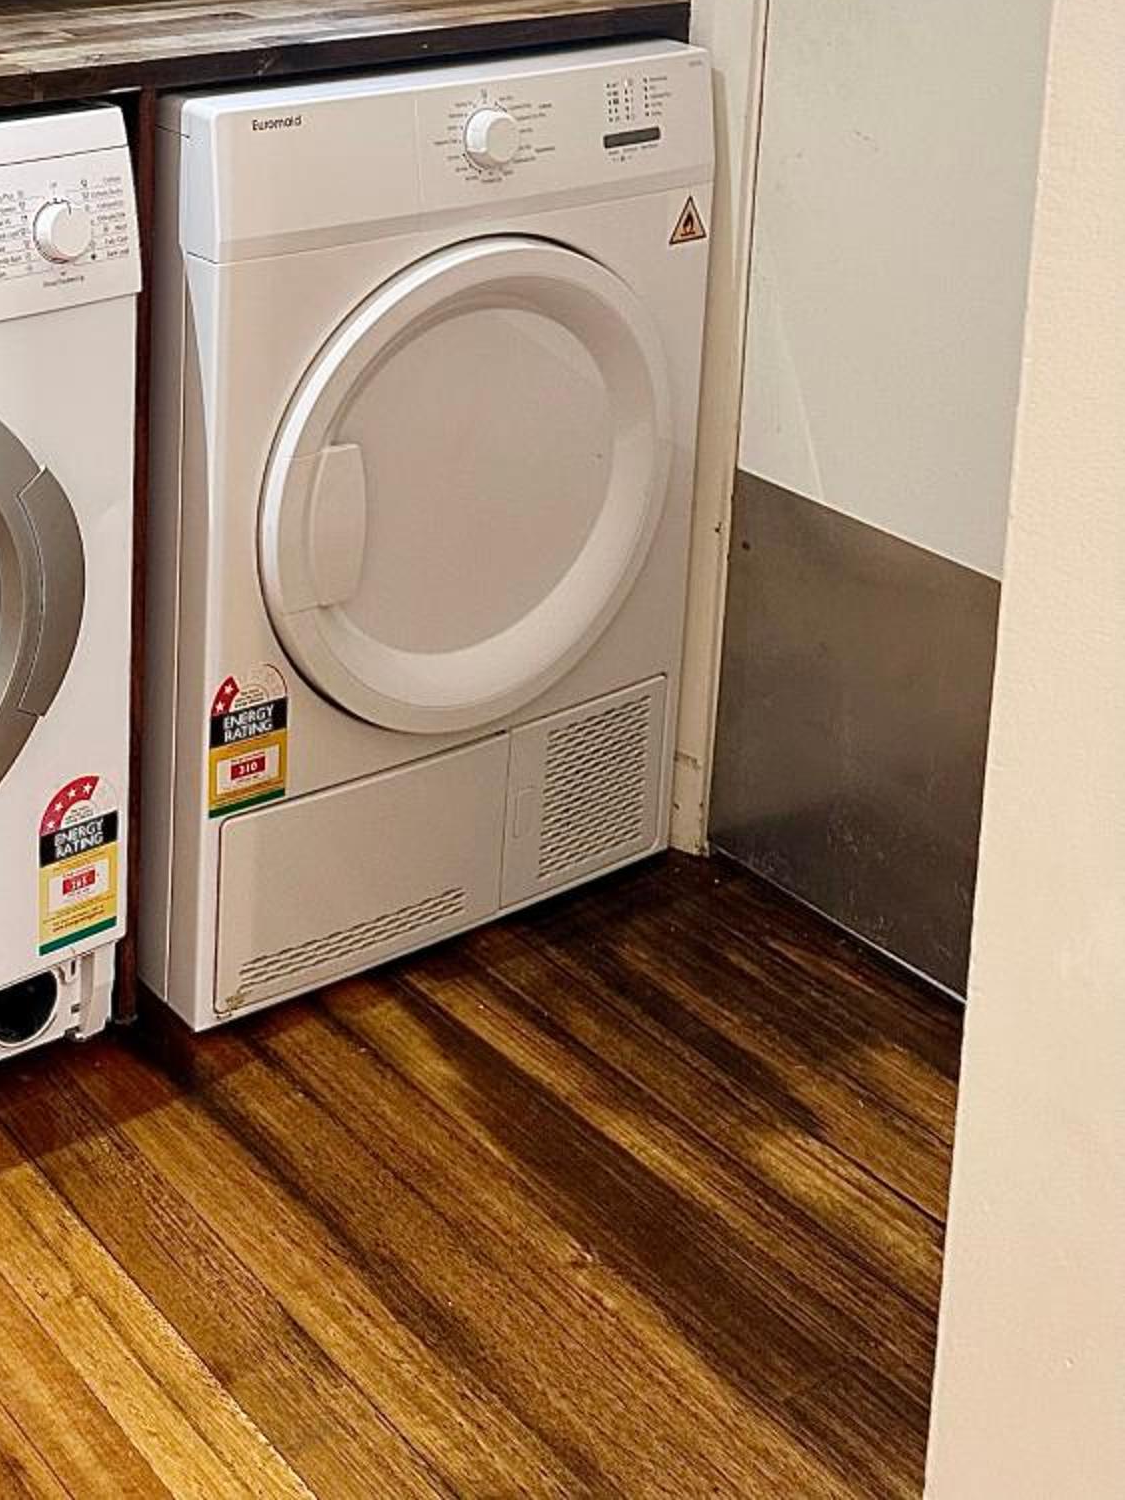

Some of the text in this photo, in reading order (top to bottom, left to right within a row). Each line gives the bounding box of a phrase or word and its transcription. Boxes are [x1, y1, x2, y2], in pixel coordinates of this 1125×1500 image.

[222, 703, 275, 730] ENERGY
[224, 720, 273, 743] RATING
[54, 818, 104, 847] ENERGY
[55, 831, 105, 859] RATING
